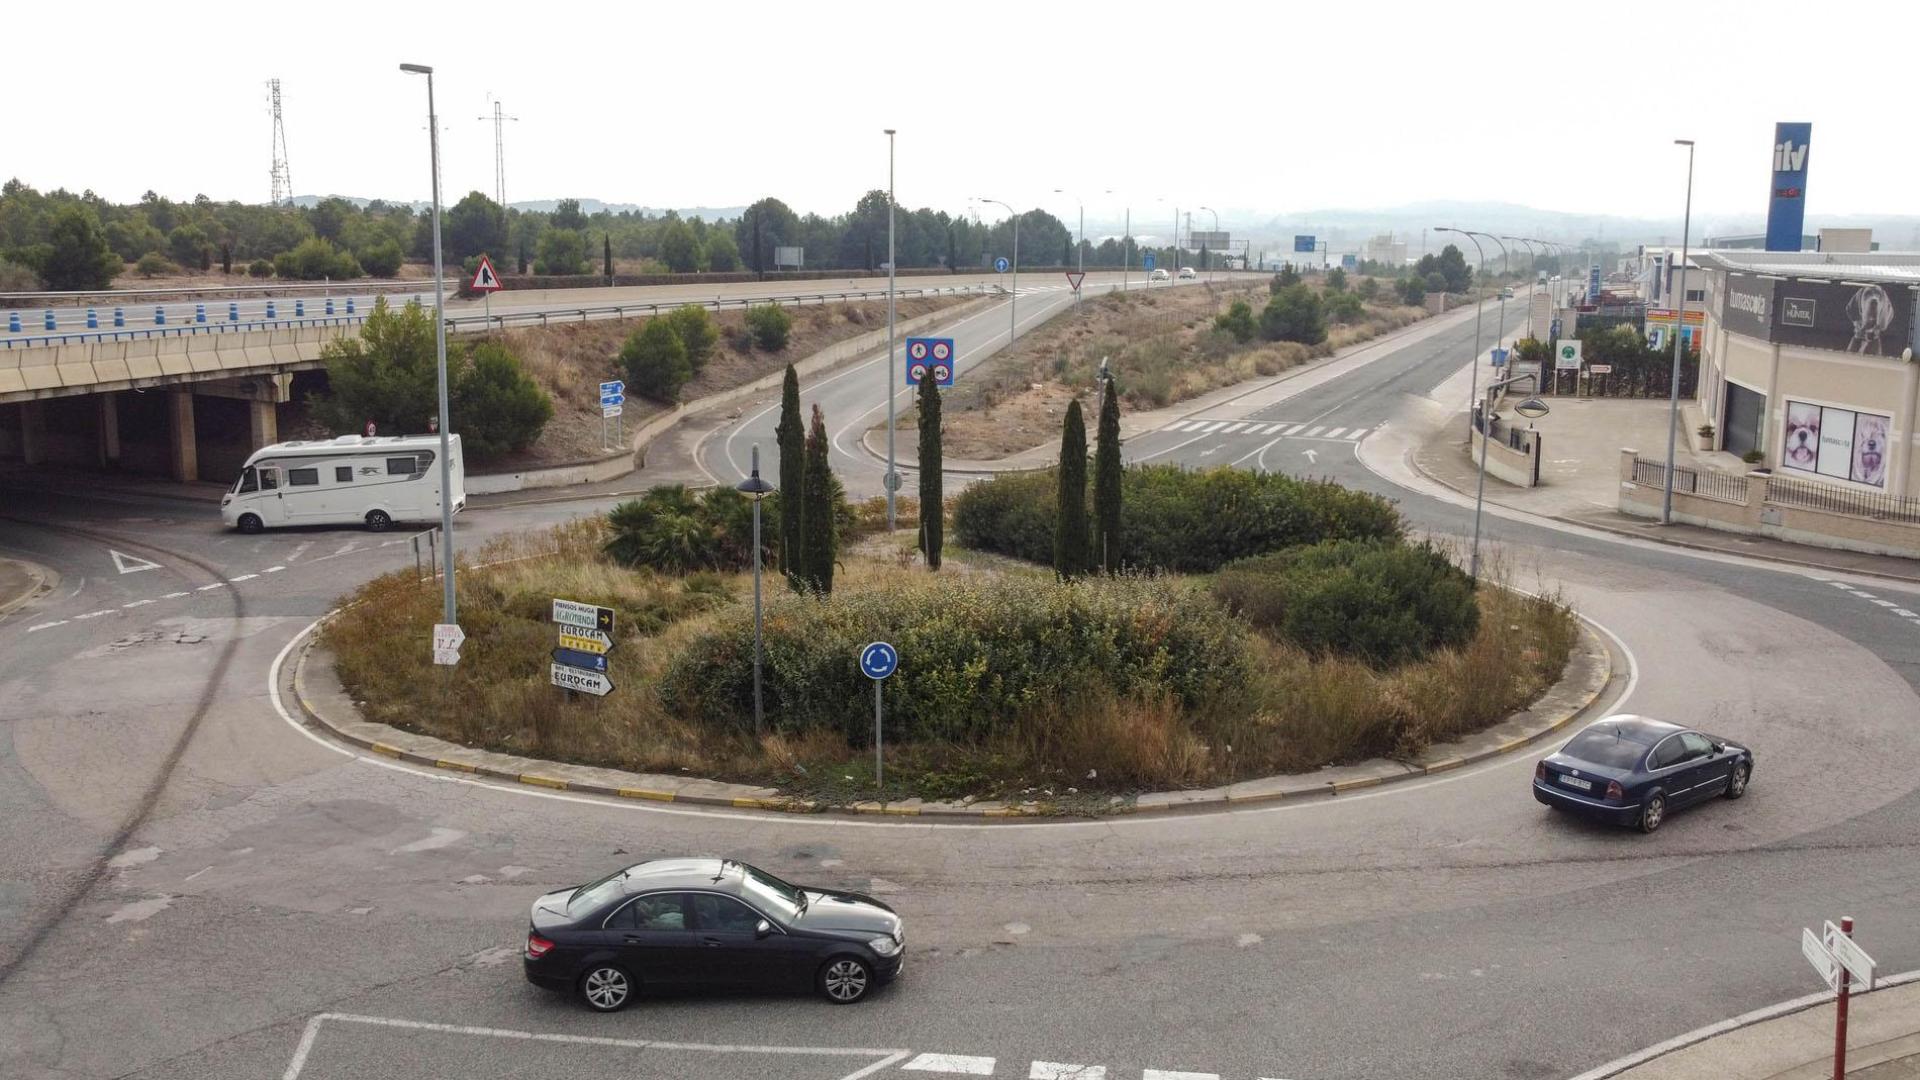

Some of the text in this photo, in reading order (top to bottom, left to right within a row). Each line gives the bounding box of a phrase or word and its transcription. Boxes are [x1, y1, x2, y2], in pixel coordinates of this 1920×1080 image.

[1774, 140, 1808, 171] itv
[561, 625, 603, 640] EUROCAM
[554, 671, 600, 689] EUROCAM
